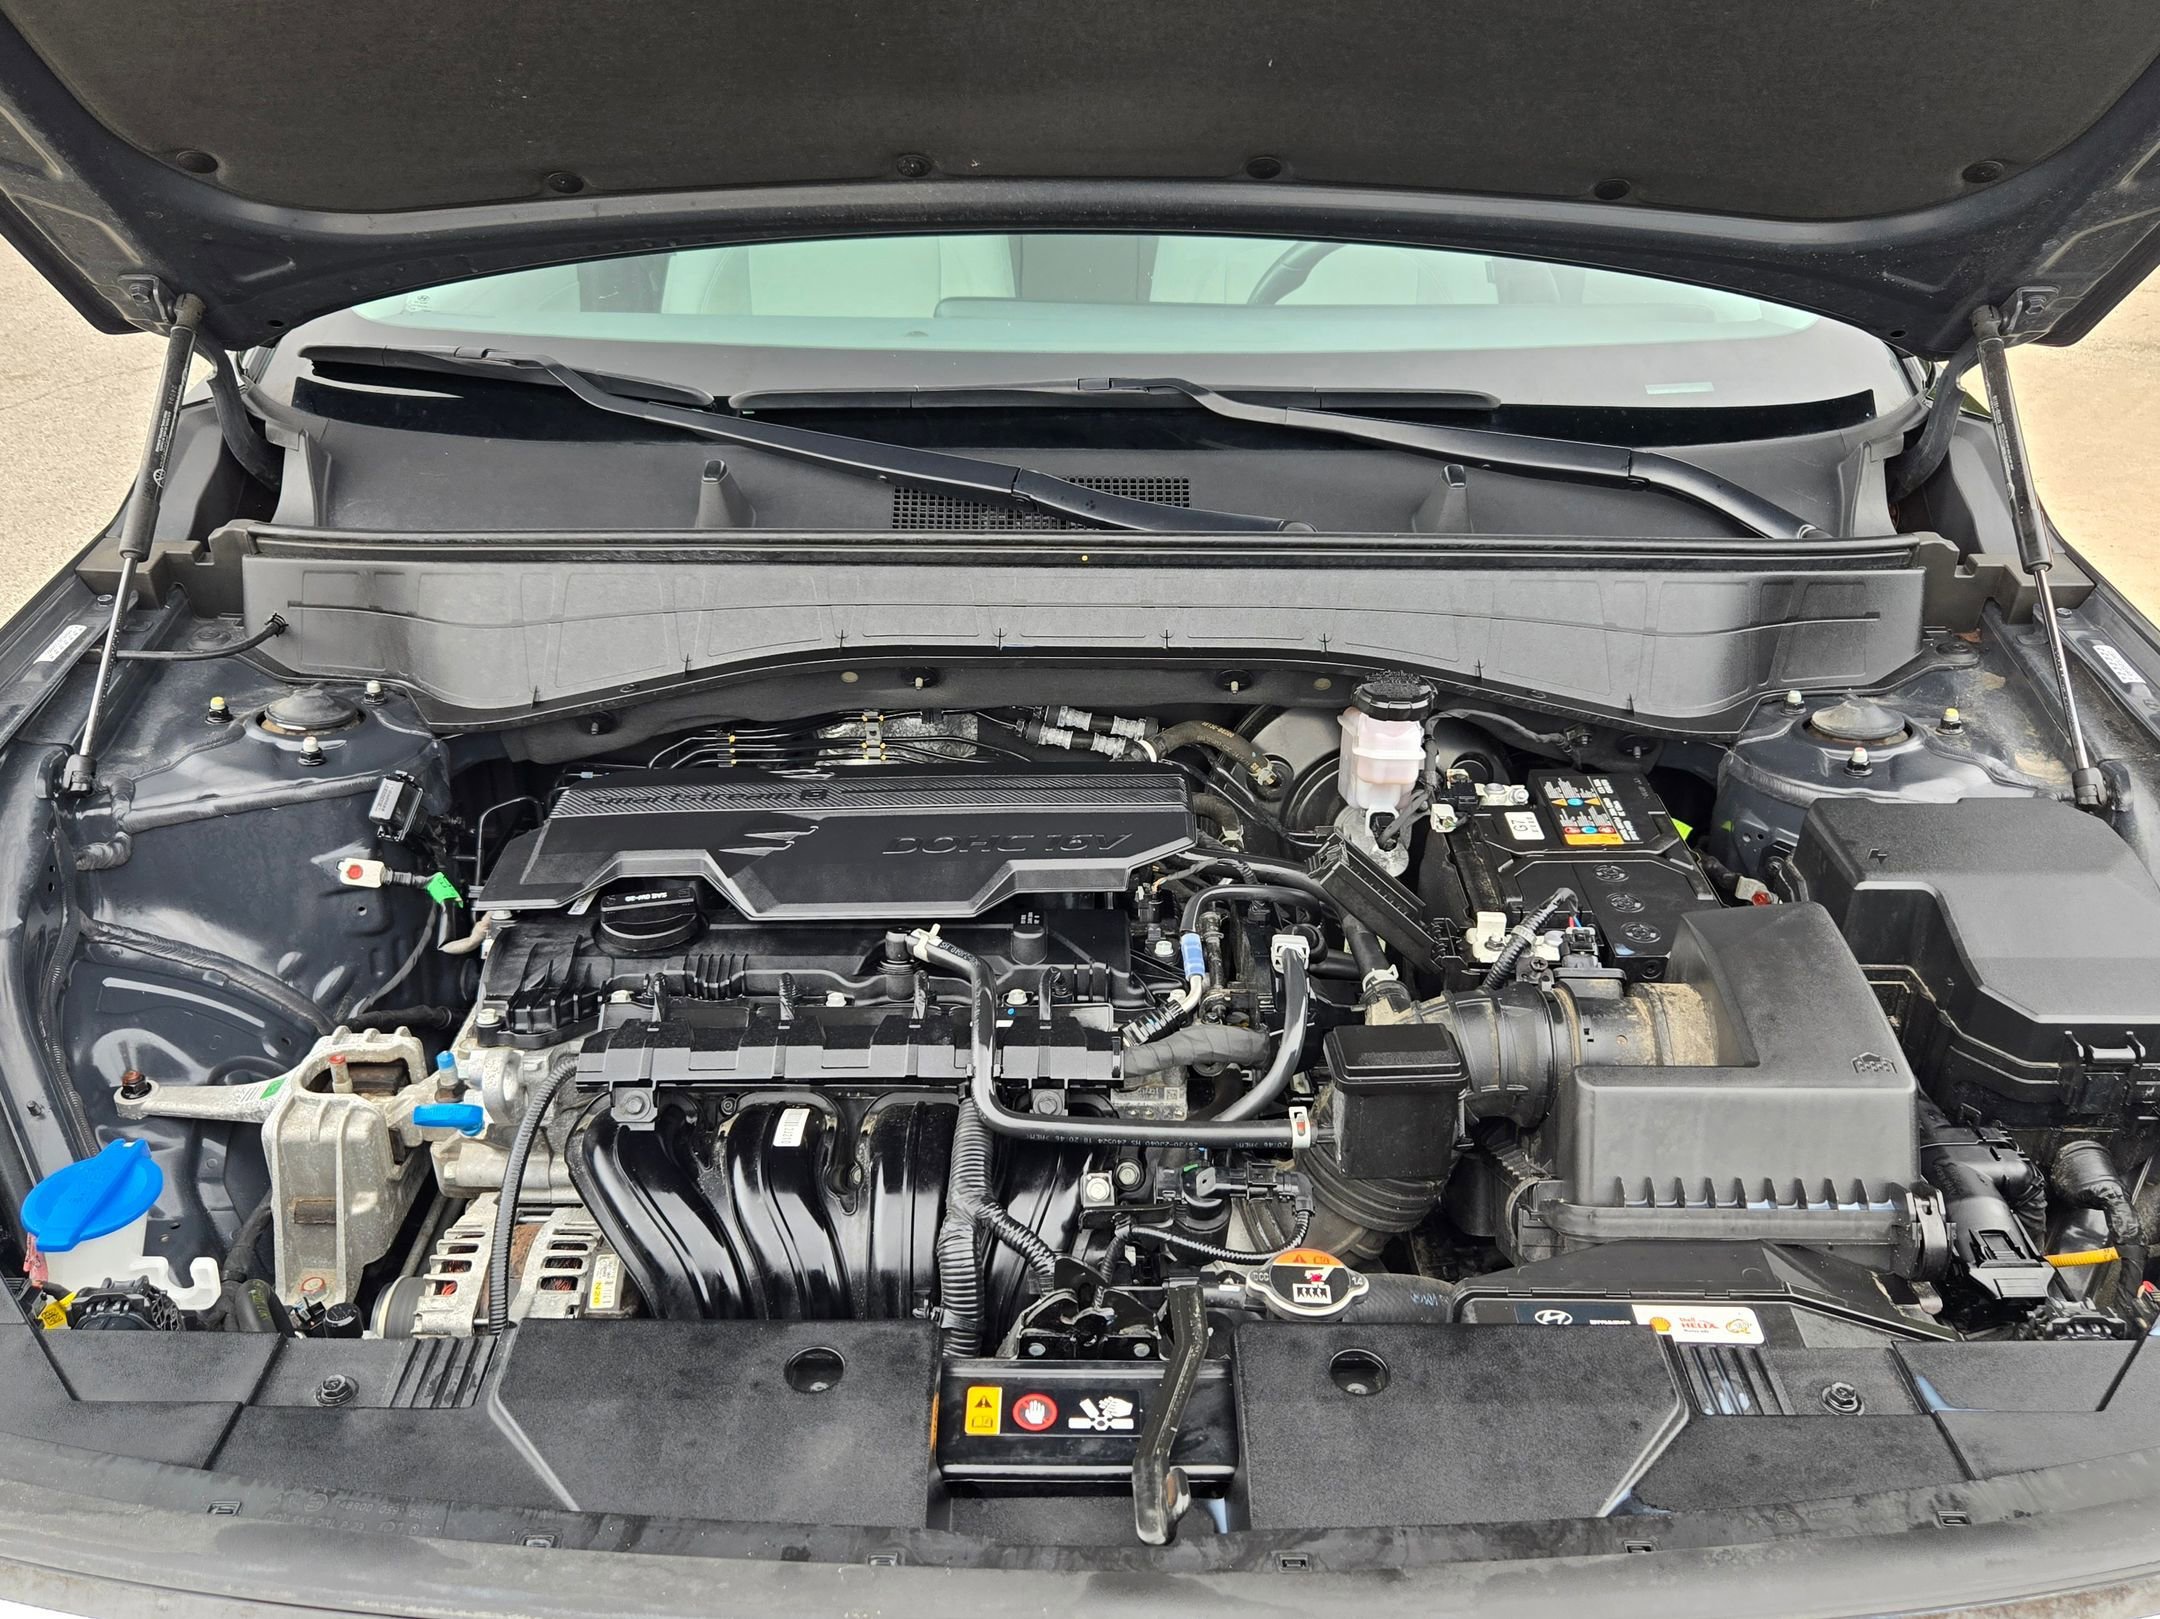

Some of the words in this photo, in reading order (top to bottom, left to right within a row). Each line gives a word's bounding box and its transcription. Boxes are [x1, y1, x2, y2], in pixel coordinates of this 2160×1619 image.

[588, 791, 793, 807] Smartstream
[882, 834, 1034, 855] DOHC
[1045, 832, 1133, 852] 16V
